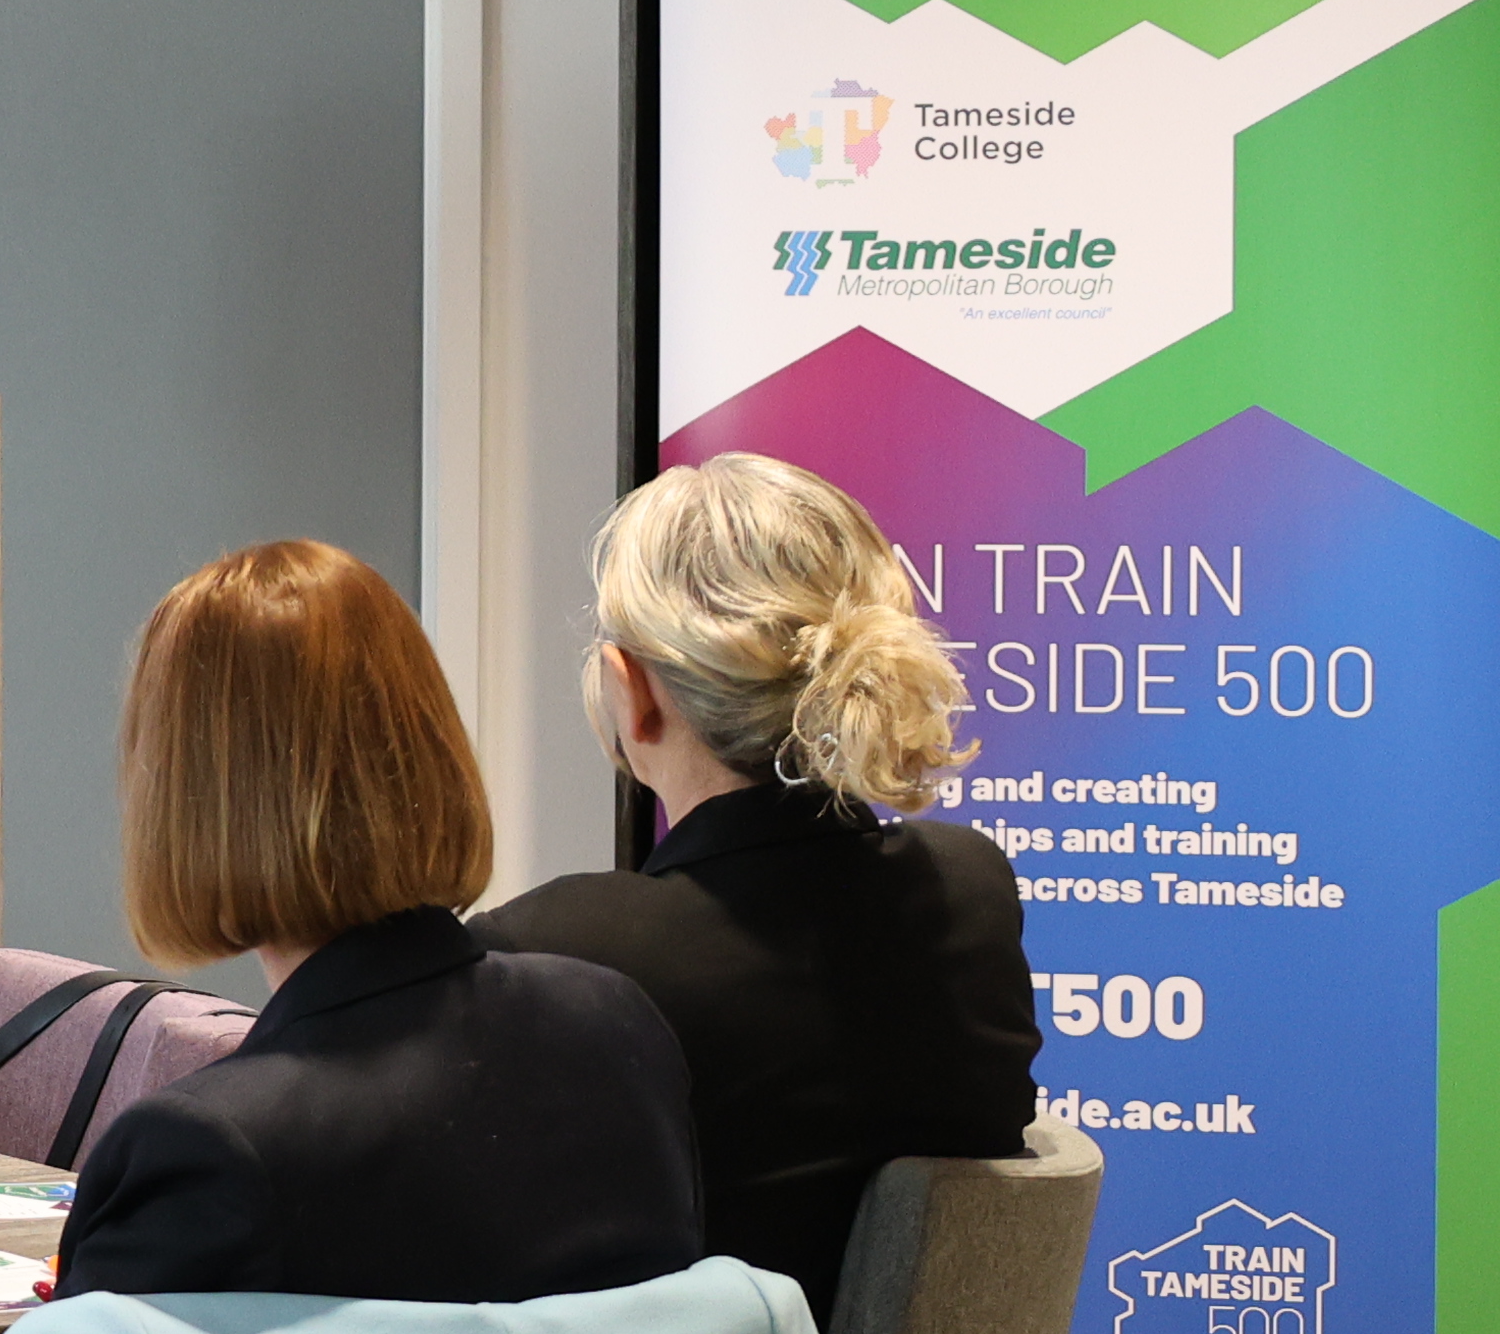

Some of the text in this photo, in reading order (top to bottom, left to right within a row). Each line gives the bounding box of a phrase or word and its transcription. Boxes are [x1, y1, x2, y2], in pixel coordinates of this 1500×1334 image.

[914, 101, 1076, 128] Tameside
[914, 134, 1044, 165] College
[840, 228, 1116, 271] Tameside
[837, 272, 1113, 301] Metropolitan Borough
[988, 307, 1052, 321] excellent
[975, 544, 1242, 617] TRAIN
[1217, 645, 1373, 719] 500
[970, 771, 1043, 802] and
[1052, 770, 1217, 813] creating
[1061, 822, 1134, 854] and
[1143, 822, 1297, 865] training
[1015, 873, 1345, 909] across Tameside
[1035, 1086, 1256, 1134] ide.ac.uk
[1202, 1244, 1305, 1275] TRAIN
[1141, 1271, 1305, 1302] TAMESIDE
